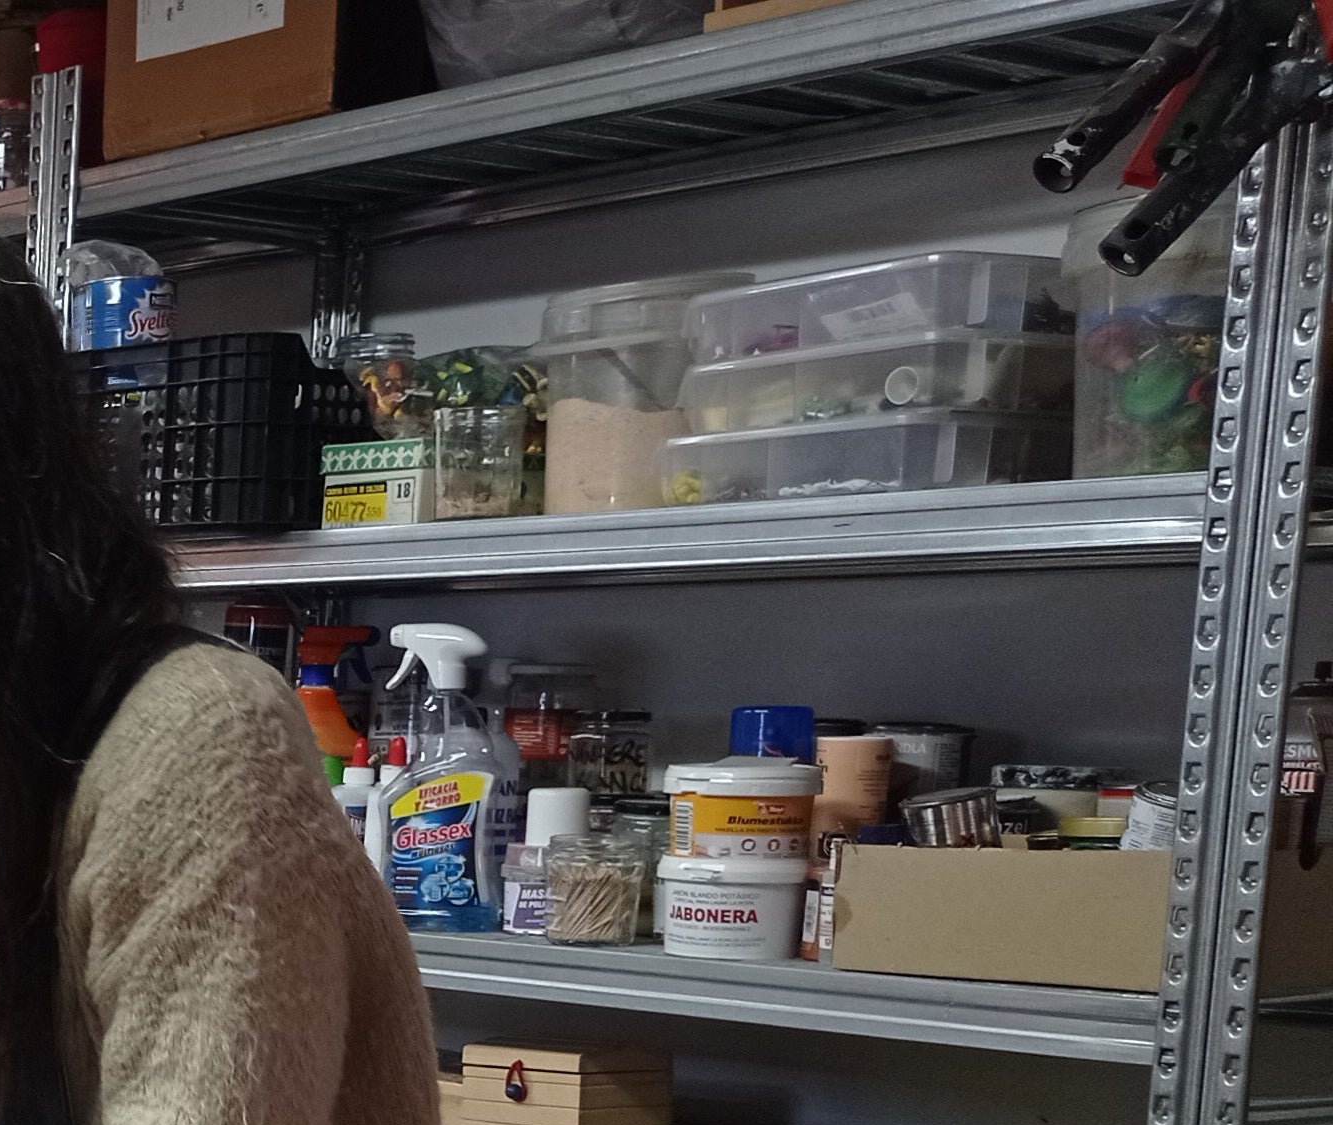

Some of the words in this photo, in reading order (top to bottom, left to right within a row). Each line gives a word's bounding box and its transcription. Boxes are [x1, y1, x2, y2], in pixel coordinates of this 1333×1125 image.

[396, 482, 411, 499] 18
[419, 782, 459, 800] EFICACIA
[421, 792, 462, 811] AORRO
[396, 822, 472, 849] Glassex
[670, 905, 758, 924] JABONERA
